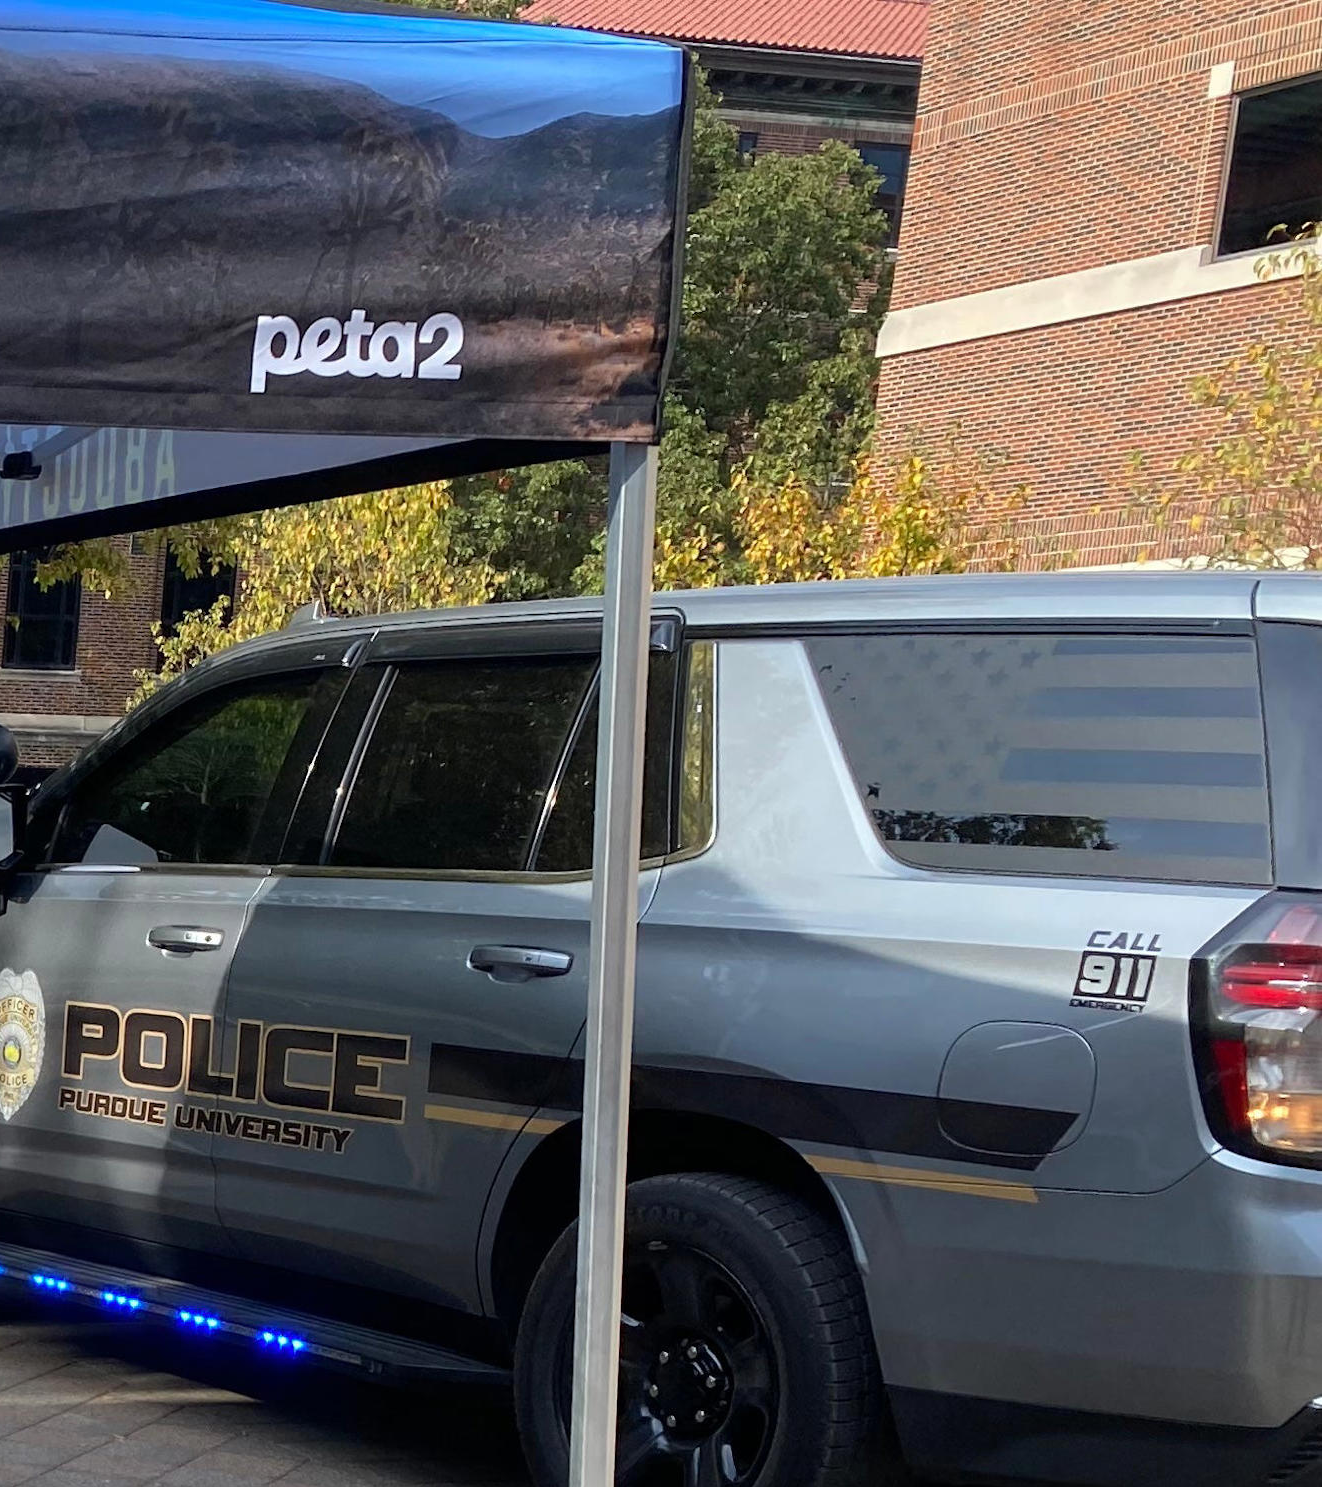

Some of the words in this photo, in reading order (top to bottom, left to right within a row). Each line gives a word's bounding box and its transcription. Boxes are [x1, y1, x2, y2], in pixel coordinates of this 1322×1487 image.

[250, 308, 463, 393] peta2
[1087, 931, 1163, 951] CALL
[1078, 955, 1154, 998] 911
[59, 1000, 411, 1124] POLICE
[58, 1088, 167, 1126] PURDUE
[174, 1104, 354, 1154] UNIVERSITY
